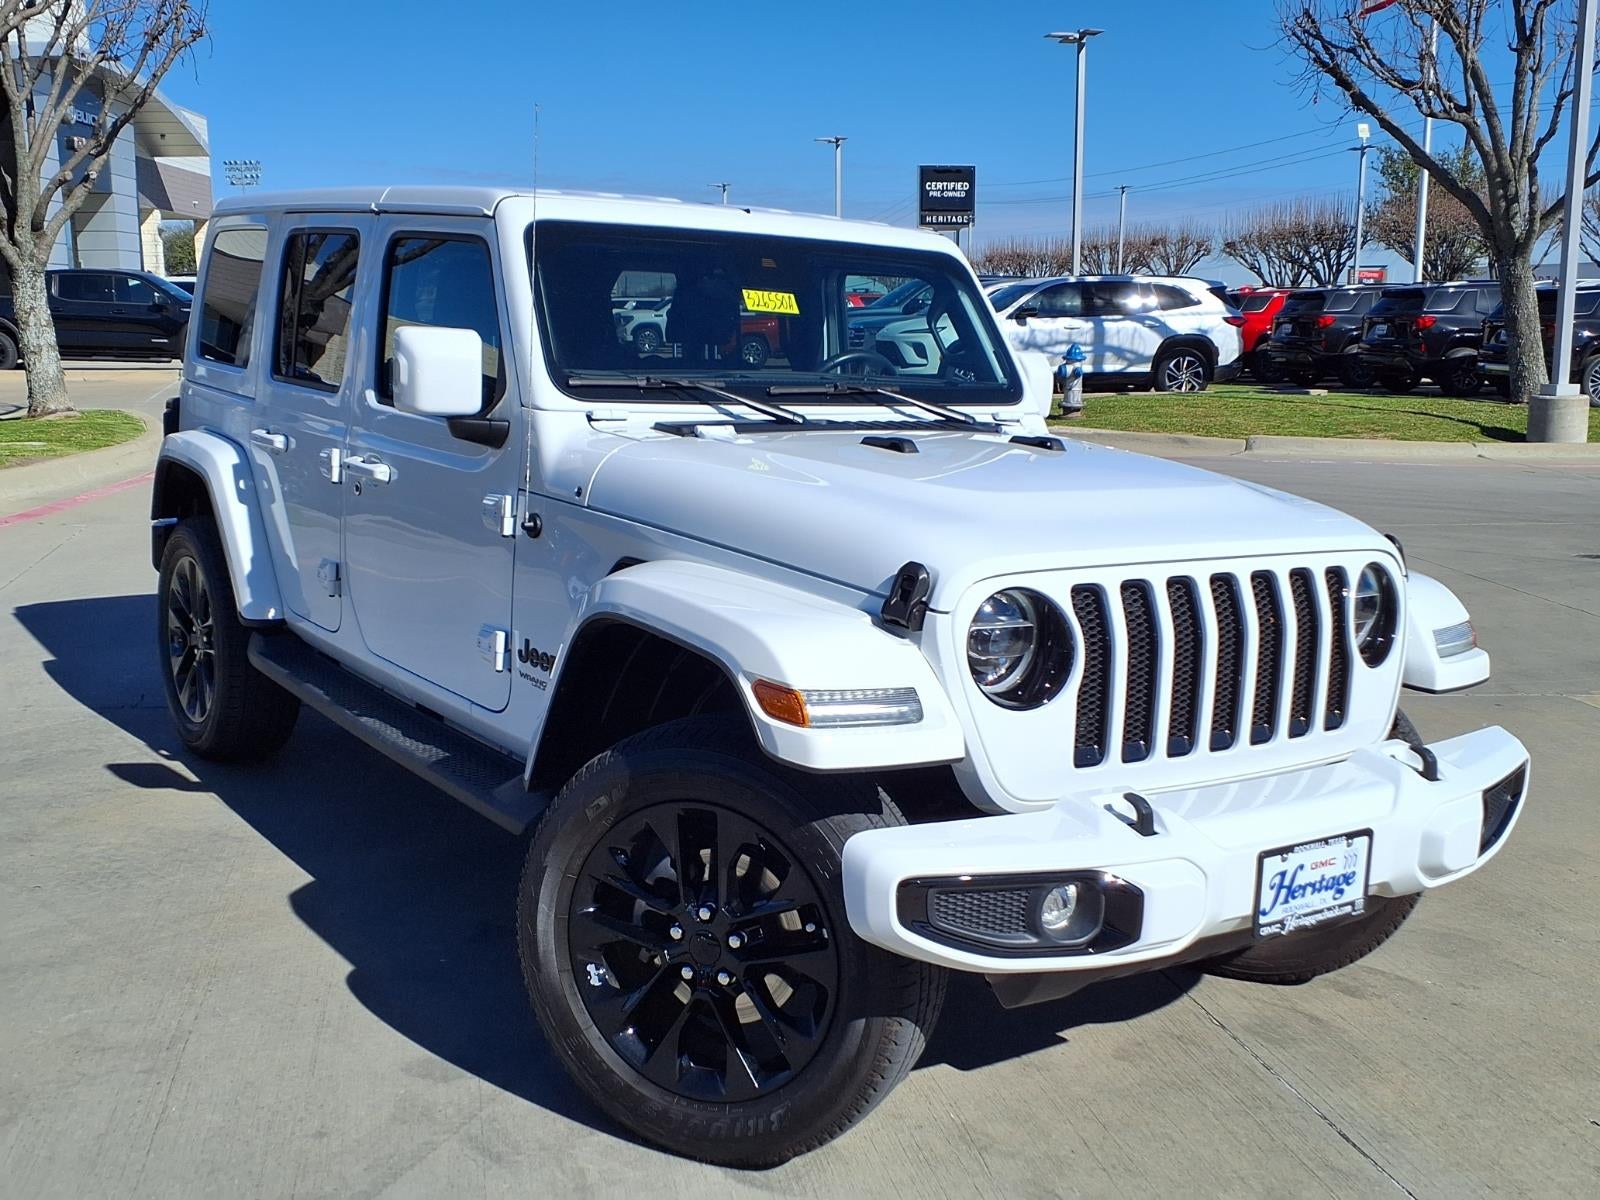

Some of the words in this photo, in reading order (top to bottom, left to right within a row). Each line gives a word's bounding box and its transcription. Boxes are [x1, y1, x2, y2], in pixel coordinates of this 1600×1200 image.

[75, 109, 98, 125] BUIC
[926, 181, 970, 191] CERTIFIED
[926, 215, 969, 223] HERITAGE
[519, 670, 547, 687] WRANG
[1310, 857, 1337, 870] GMC
[1259, 863, 1356, 917] Heritage
